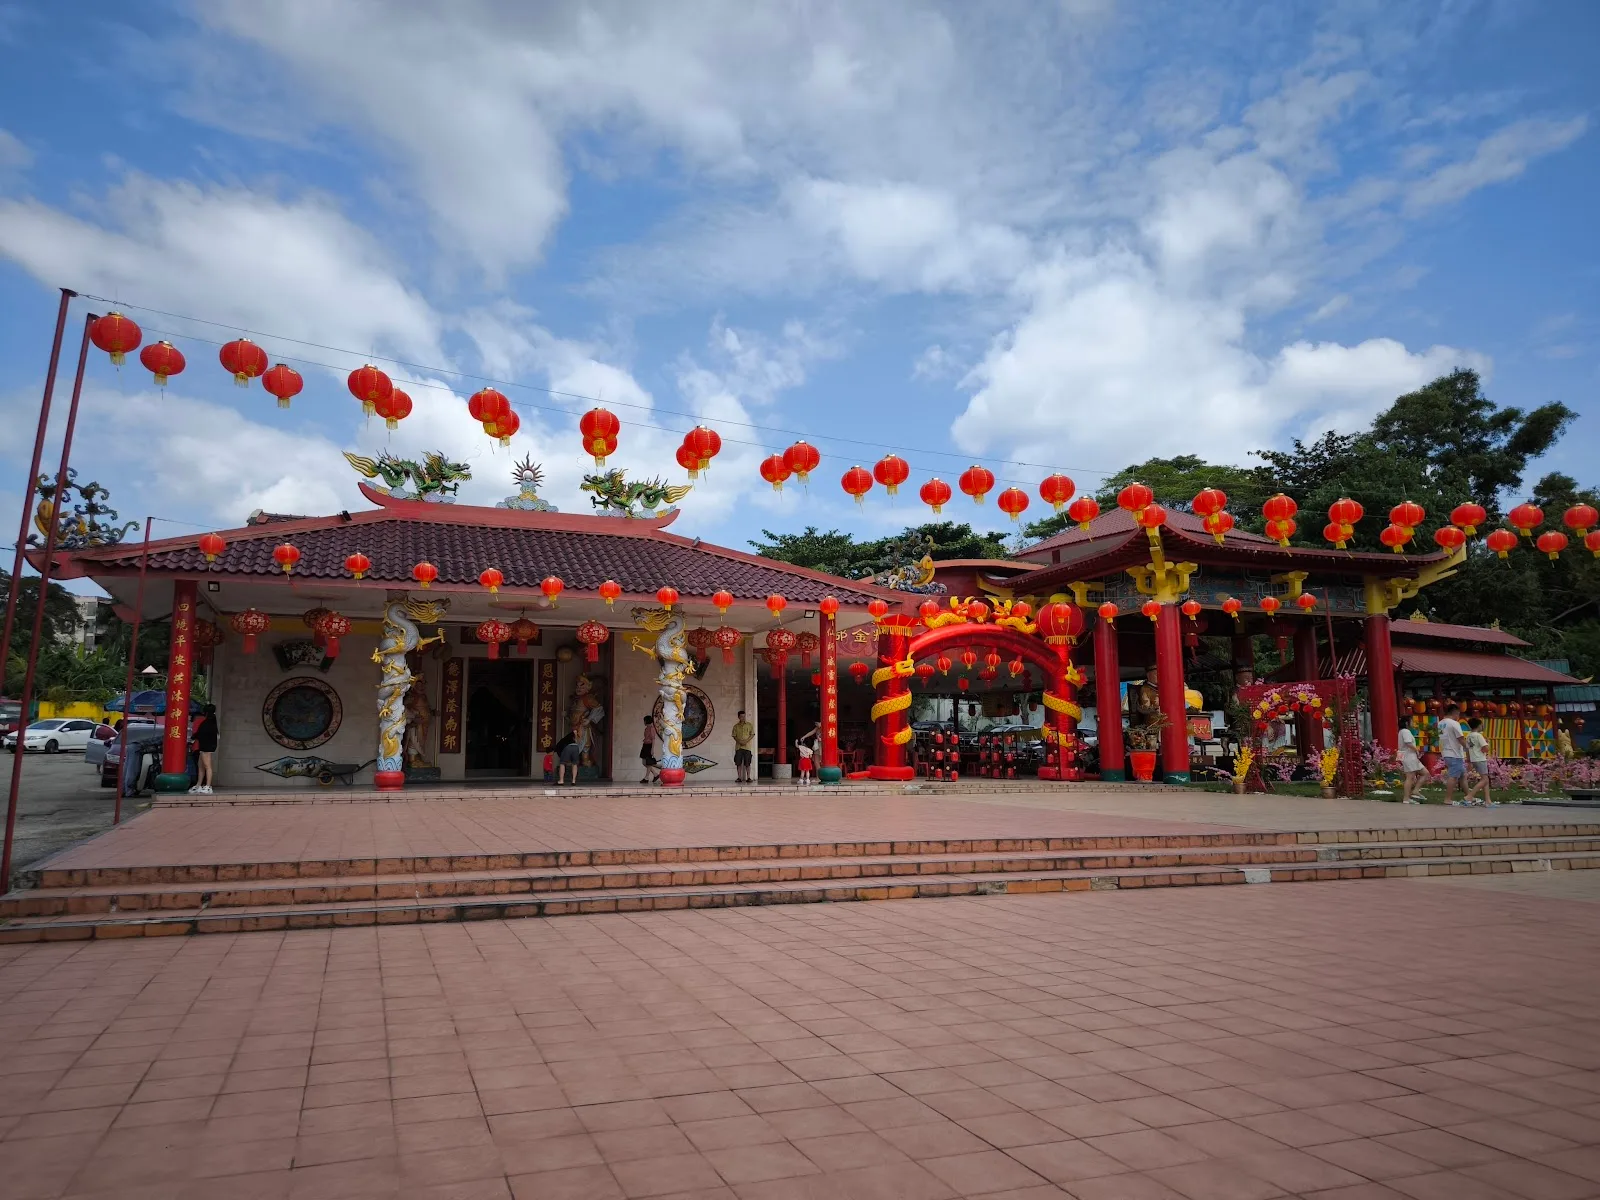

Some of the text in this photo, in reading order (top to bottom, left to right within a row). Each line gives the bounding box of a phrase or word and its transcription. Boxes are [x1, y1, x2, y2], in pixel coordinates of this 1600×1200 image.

[540, 663, 554, 749] 恩光昭宇宙
